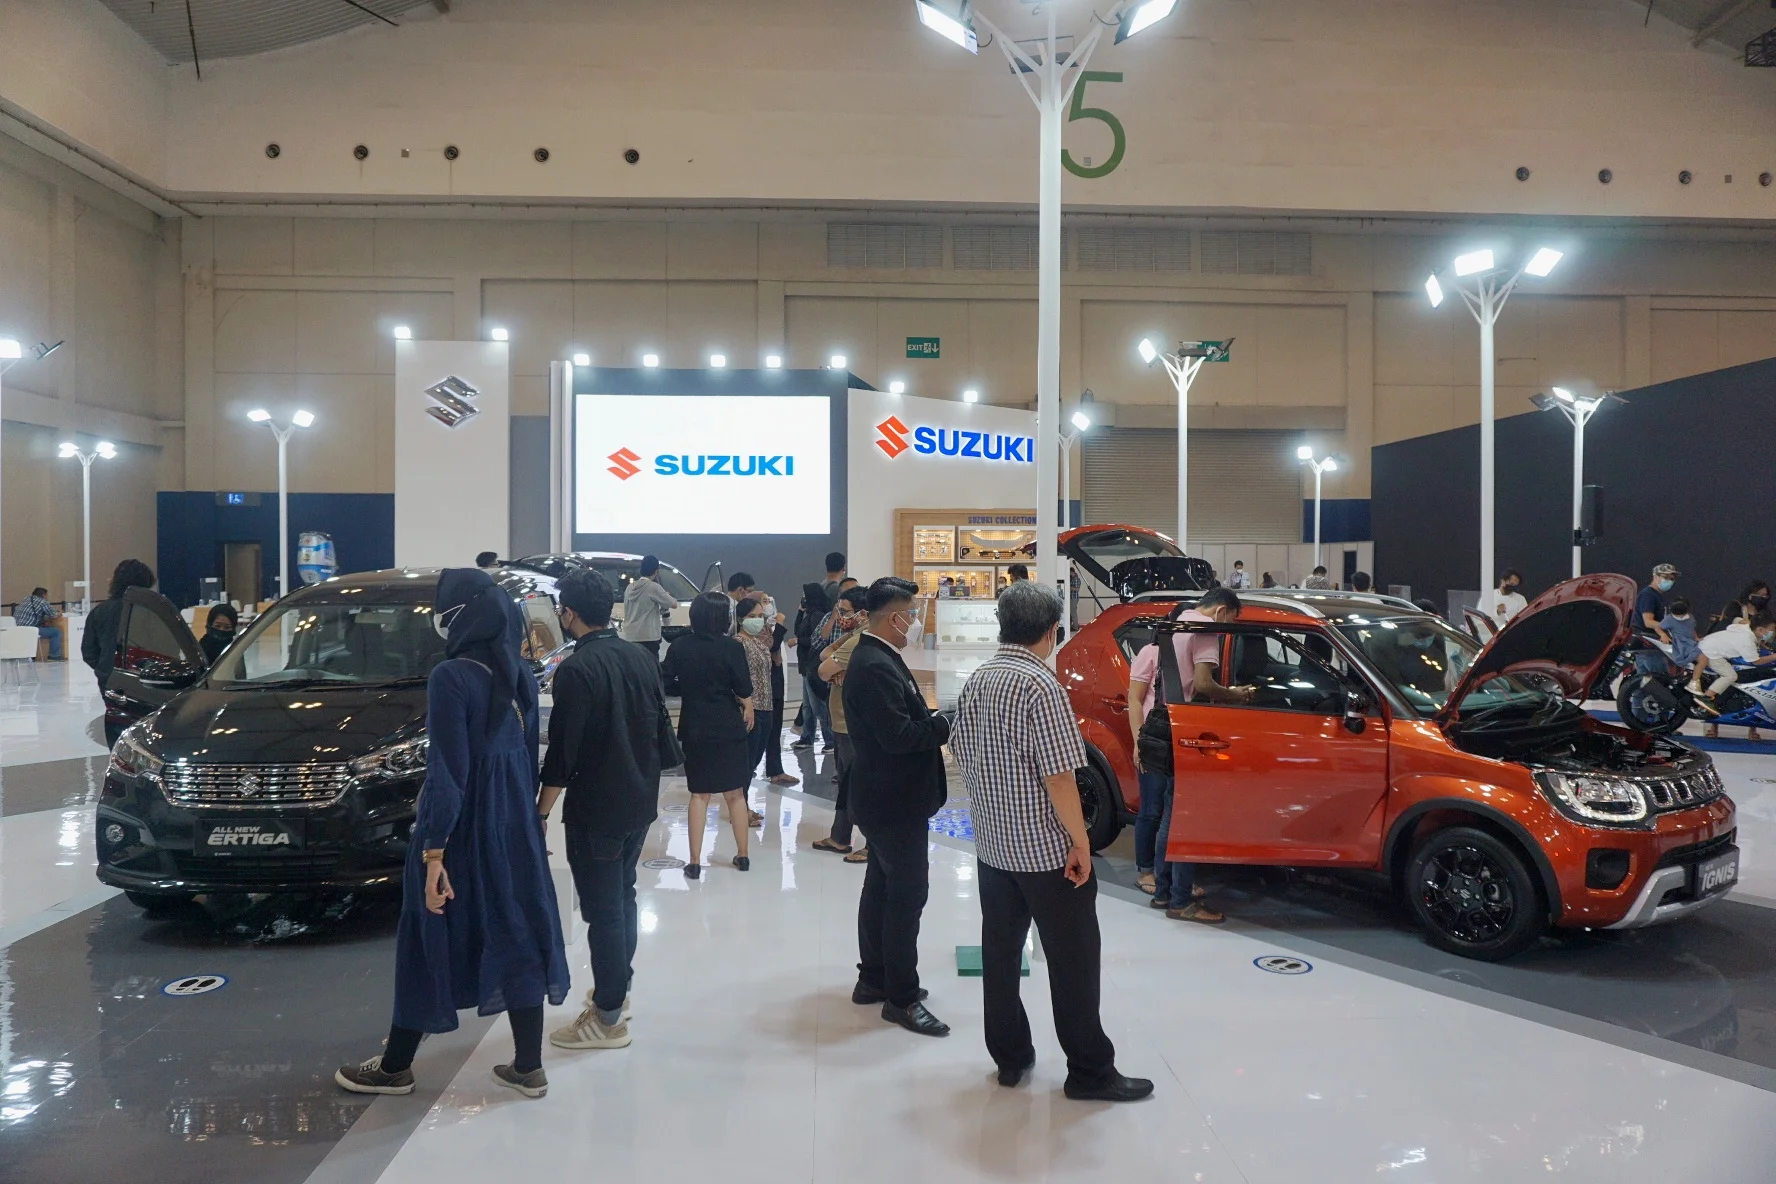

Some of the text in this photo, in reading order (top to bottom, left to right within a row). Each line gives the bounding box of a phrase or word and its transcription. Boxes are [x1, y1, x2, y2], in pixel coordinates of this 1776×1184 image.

[1061, 70, 1126, 178] 5
[914, 427, 1034, 462] SUZUKI
[654, 454, 794, 476] SUZUKI
[968, 516, 1037, 525] SUZUKI COLLECTION
[207, 832, 290, 846] ERTIGA
[1701, 861, 1736, 891] IGNIS
